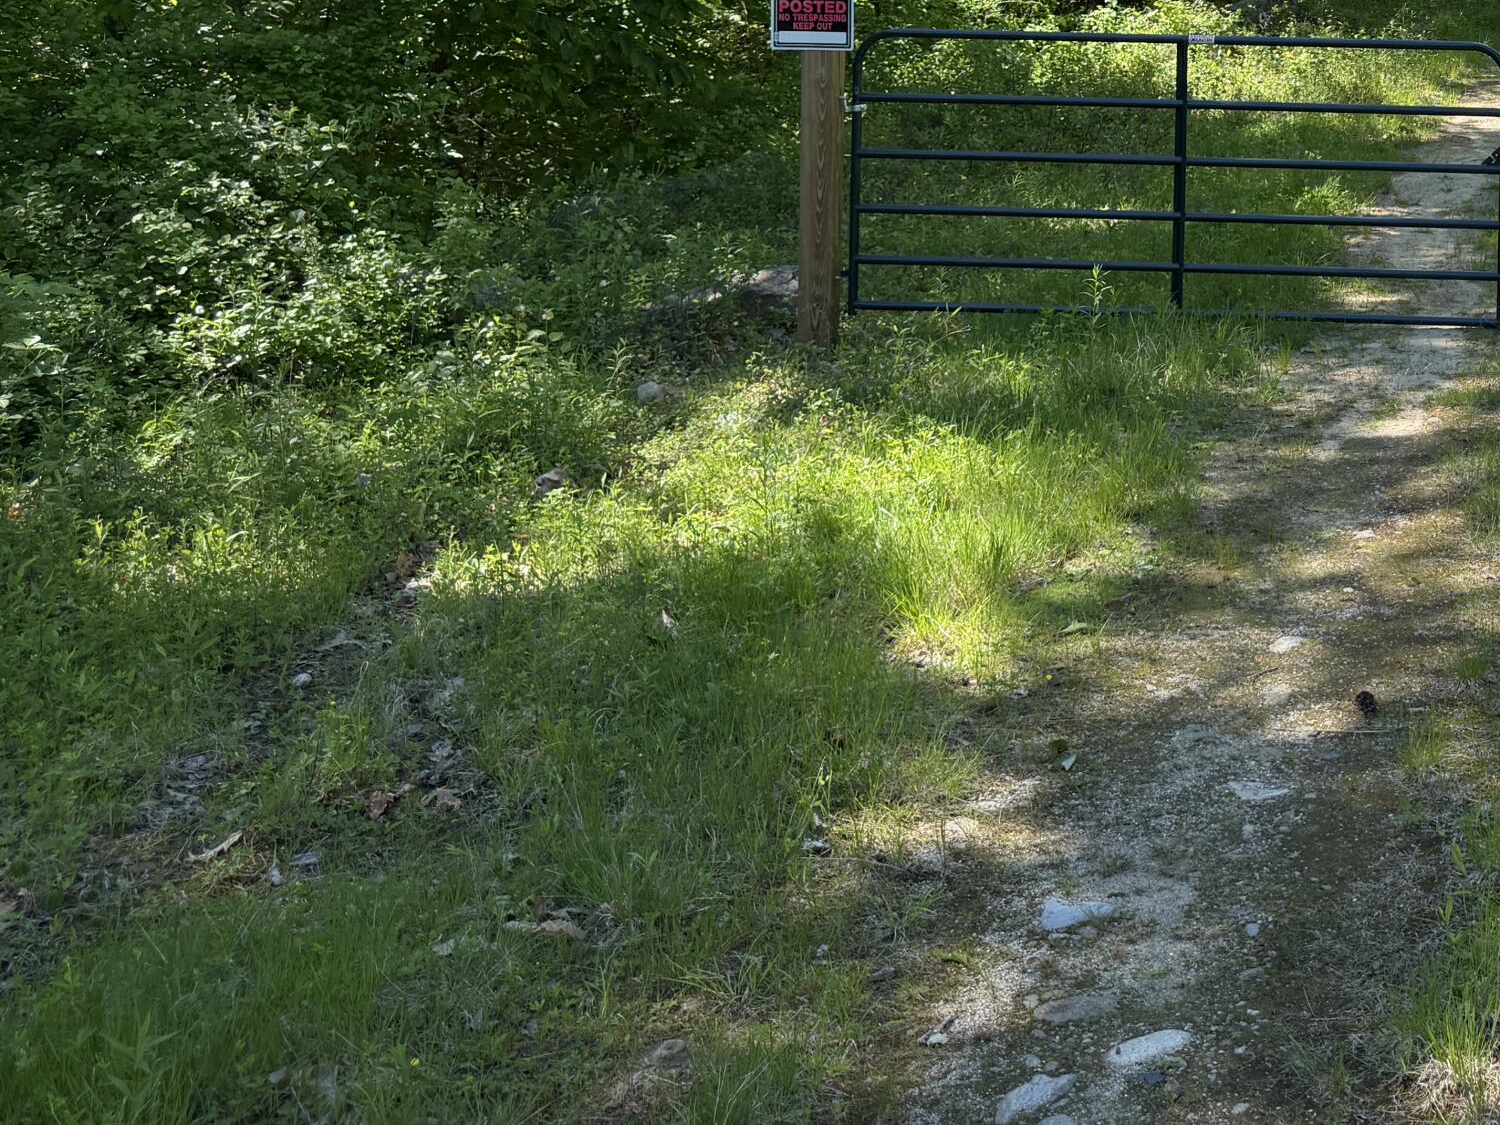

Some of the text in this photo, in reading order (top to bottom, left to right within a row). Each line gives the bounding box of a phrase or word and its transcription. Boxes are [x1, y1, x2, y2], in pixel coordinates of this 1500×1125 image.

[778, 0, 847, 14] POSTED
[778, 13, 847, 23] NO TRESPASSING
[793, 22, 833, 30] KEEP OUT
